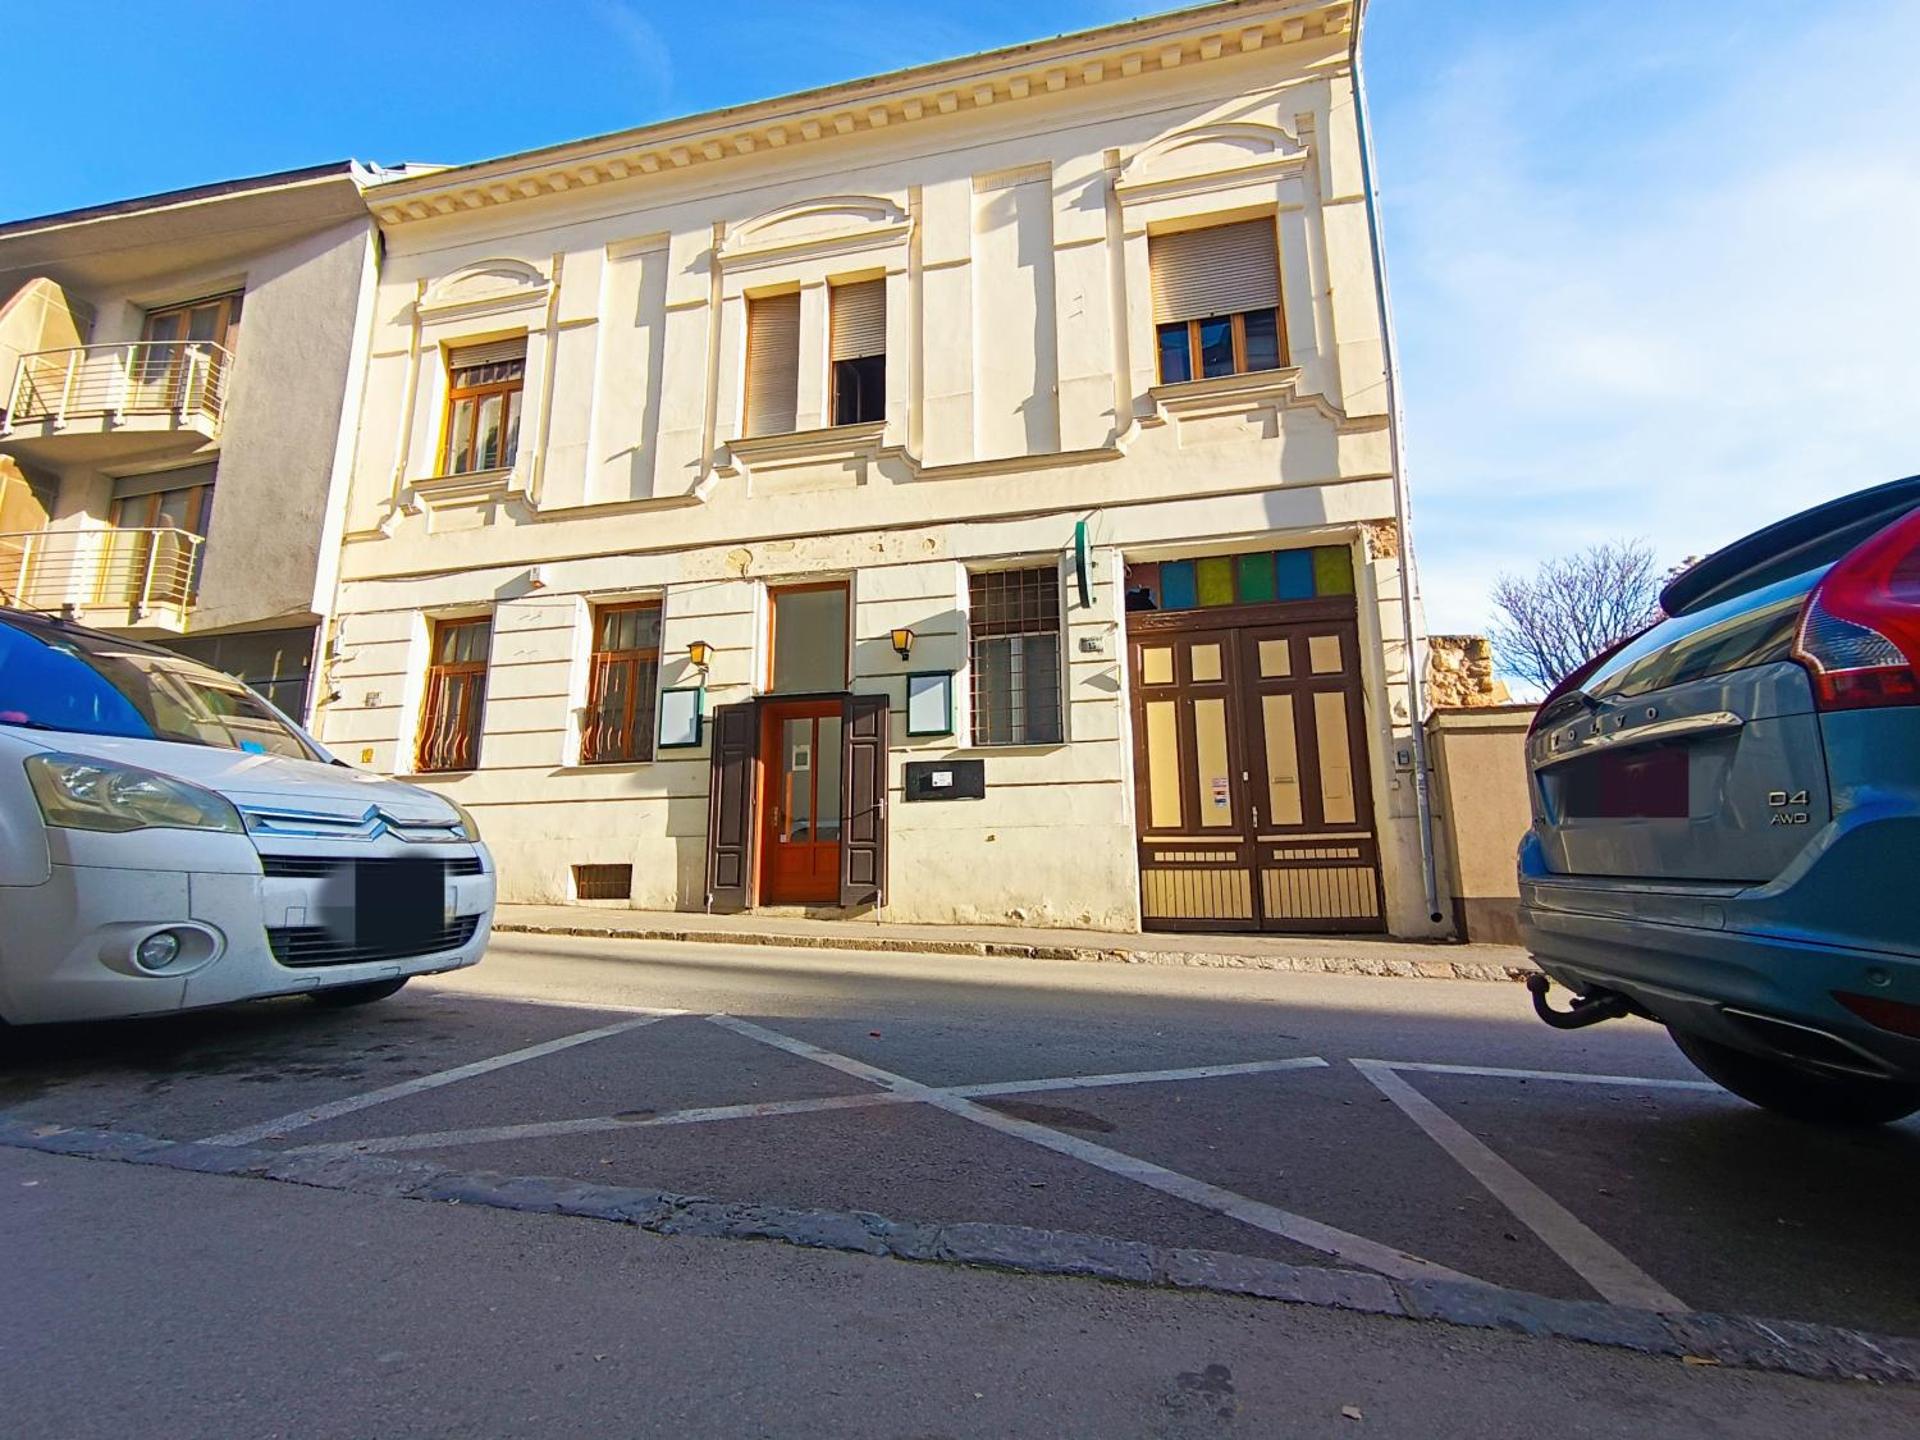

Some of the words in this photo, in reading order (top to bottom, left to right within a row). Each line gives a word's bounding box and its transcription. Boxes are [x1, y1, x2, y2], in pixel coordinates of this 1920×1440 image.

[1551, 707, 1658, 751] VOLVO
[1768, 790, 1808, 806] D4
[1770, 812, 1807, 825] AWD
